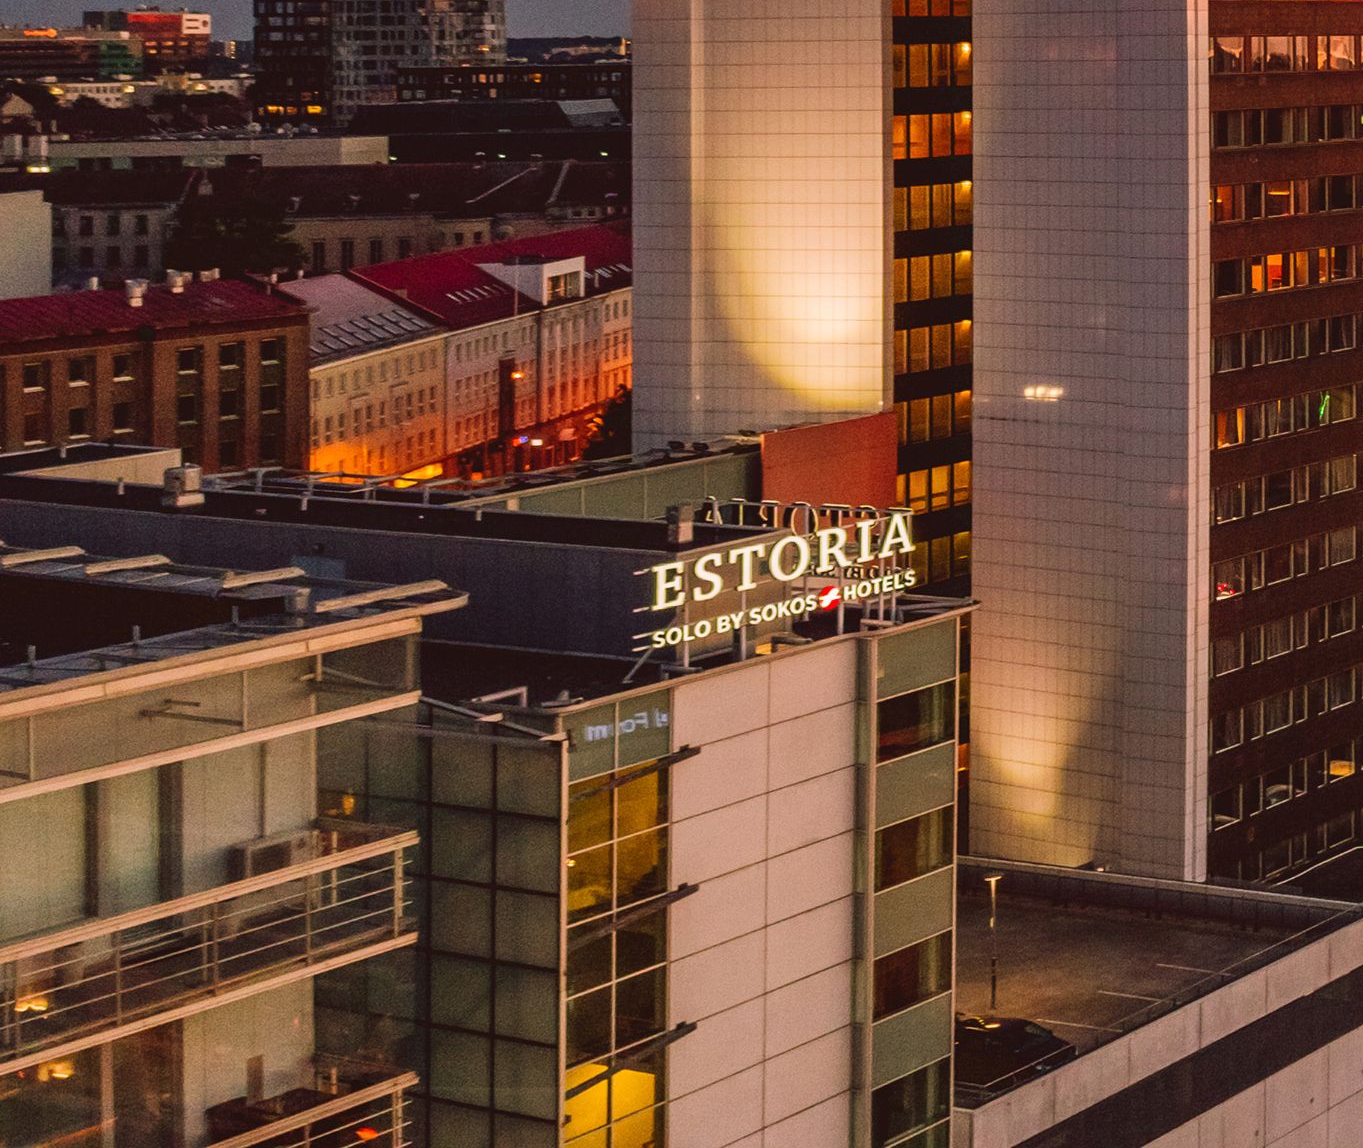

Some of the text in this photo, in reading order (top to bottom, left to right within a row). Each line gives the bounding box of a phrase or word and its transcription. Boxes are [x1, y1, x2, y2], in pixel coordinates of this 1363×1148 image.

[651, 512, 916, 612] ESTORIA
[652, 620, 711, 648] SOLO
[716, 612, 744, 634] BY
[750, 594, 818, 625] SOKOS
[843, 570, 916, 601] HOTELS
